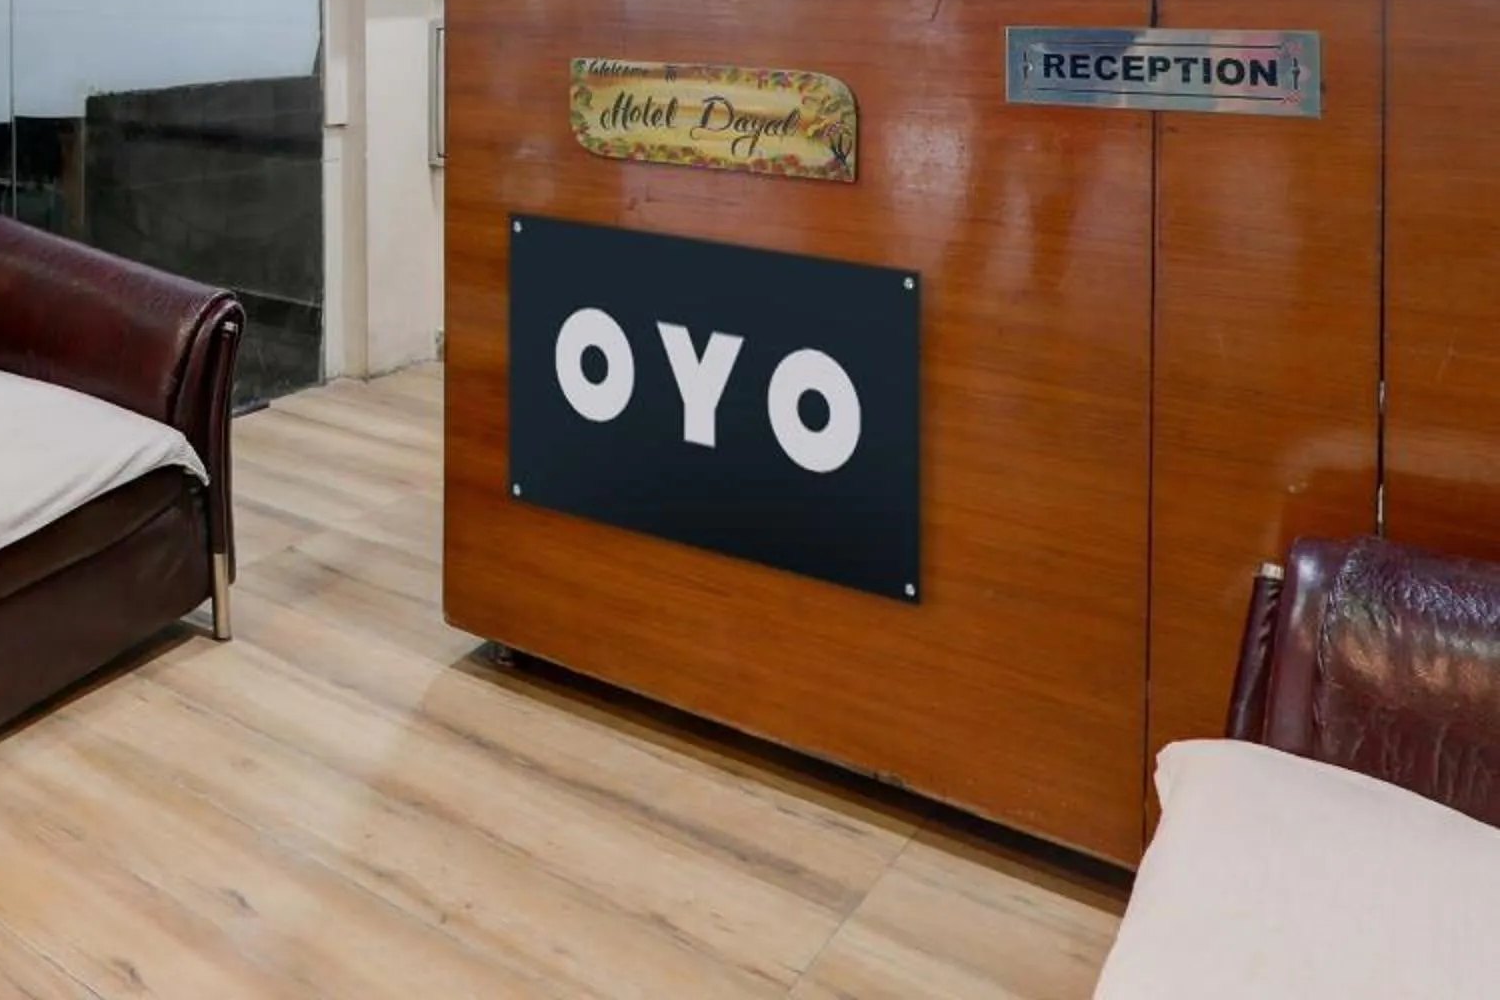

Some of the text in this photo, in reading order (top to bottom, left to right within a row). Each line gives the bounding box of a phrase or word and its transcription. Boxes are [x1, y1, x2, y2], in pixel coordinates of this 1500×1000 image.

[1043, 53, 1278, 87] RECEPTION
[600, 91, 800, 157] Hotel Dayal
[555, 307, 861, 473] OYO
